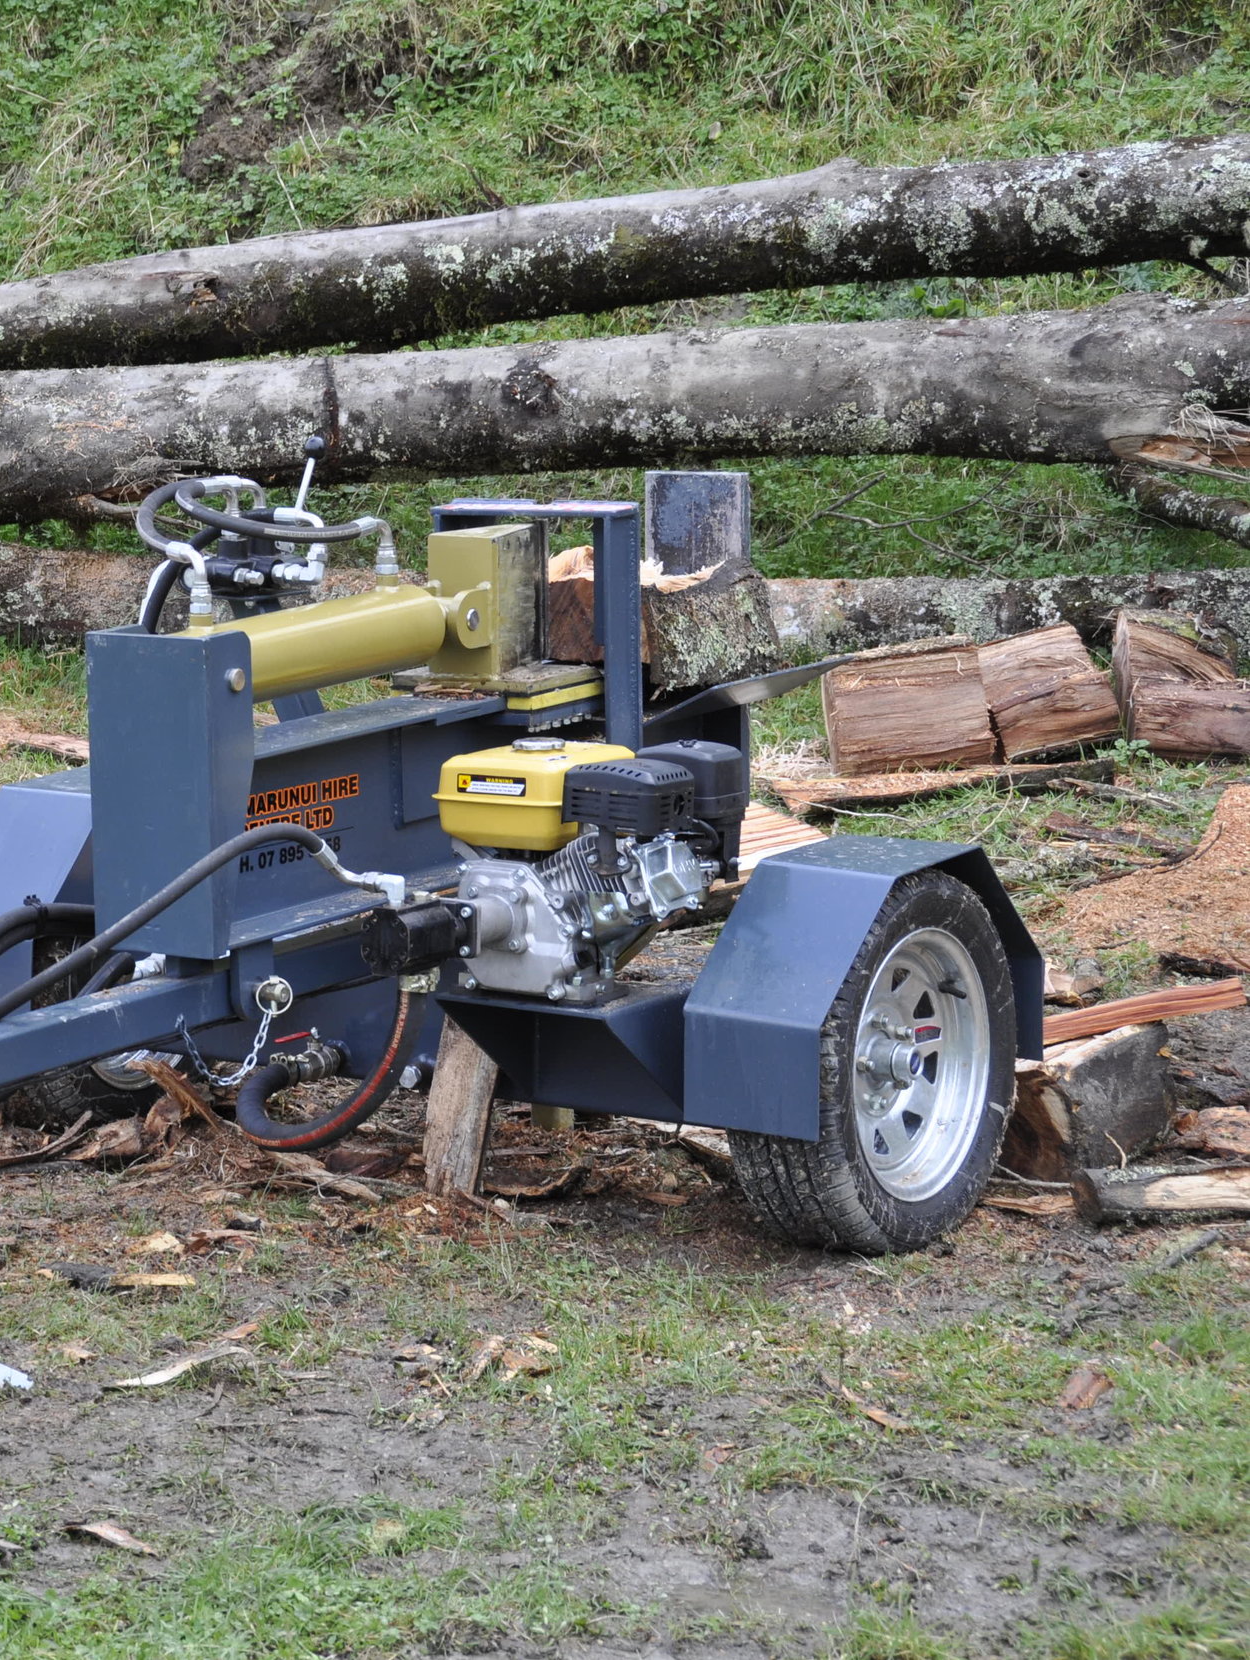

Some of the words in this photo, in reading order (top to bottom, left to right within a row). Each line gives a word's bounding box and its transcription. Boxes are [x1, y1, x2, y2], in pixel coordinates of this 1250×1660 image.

[321, 774, 359, 802] HIRE
[305, 806, 333, 831] LTD
[258, 851, 274, 869] 07
[279, 846, 304, 865] 895
